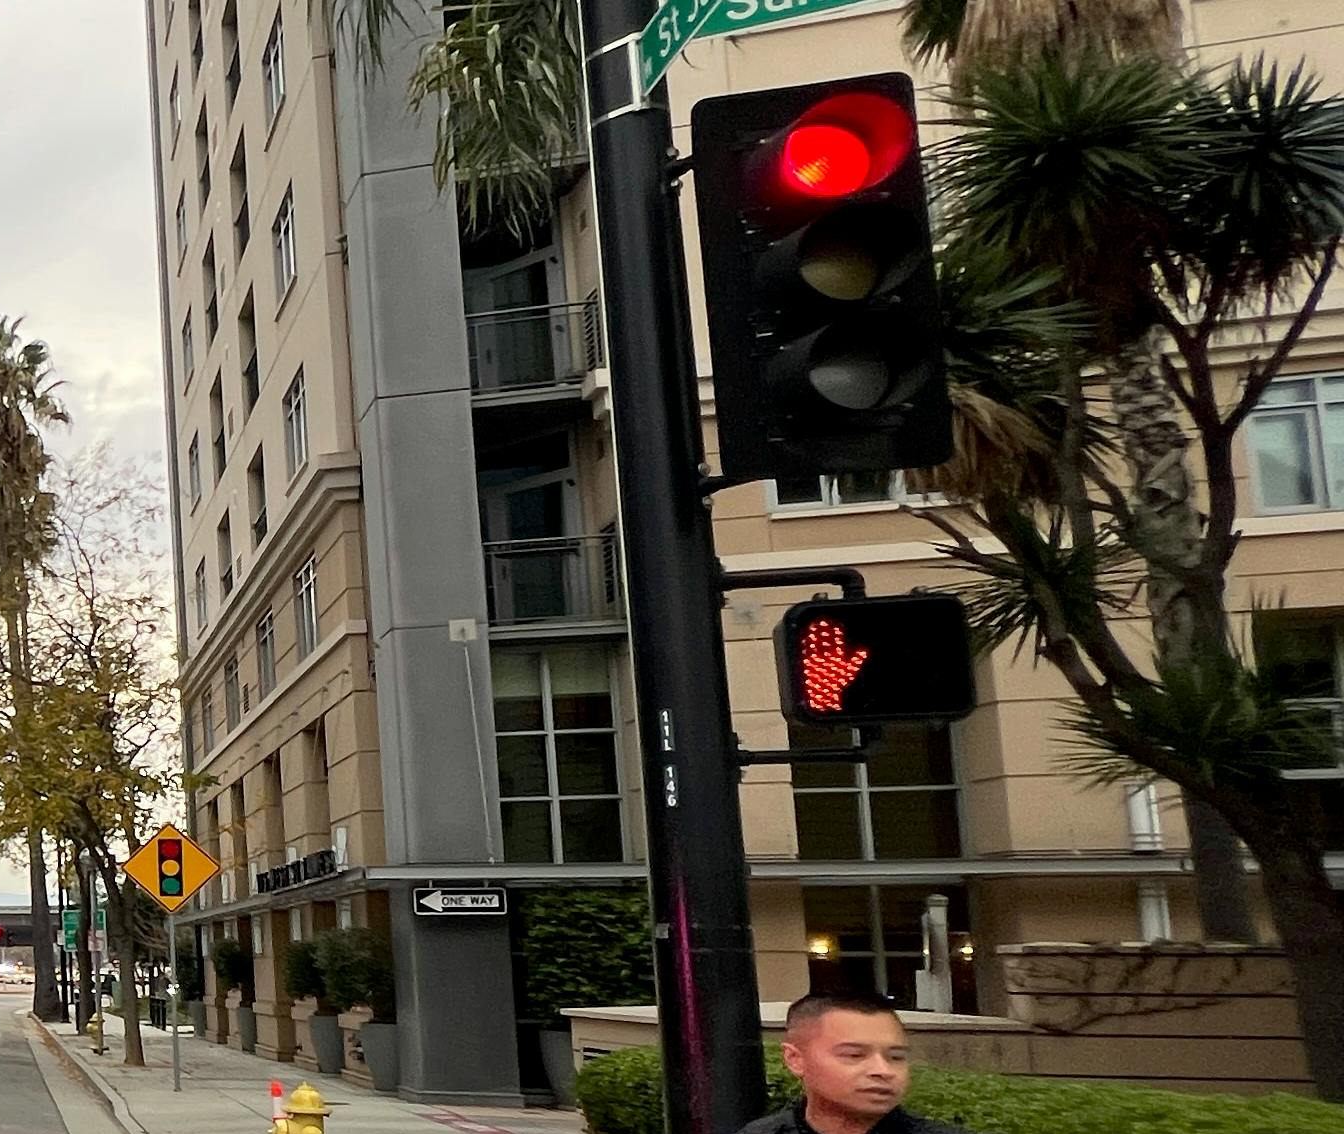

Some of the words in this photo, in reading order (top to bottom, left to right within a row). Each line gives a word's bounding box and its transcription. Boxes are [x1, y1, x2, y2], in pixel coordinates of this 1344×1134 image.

[659, 6, 681, 57] St
[666, 766, 677, 807] 146
[441, 896, 465, 907] ONE
[470, 895, 496, 906] WAY
